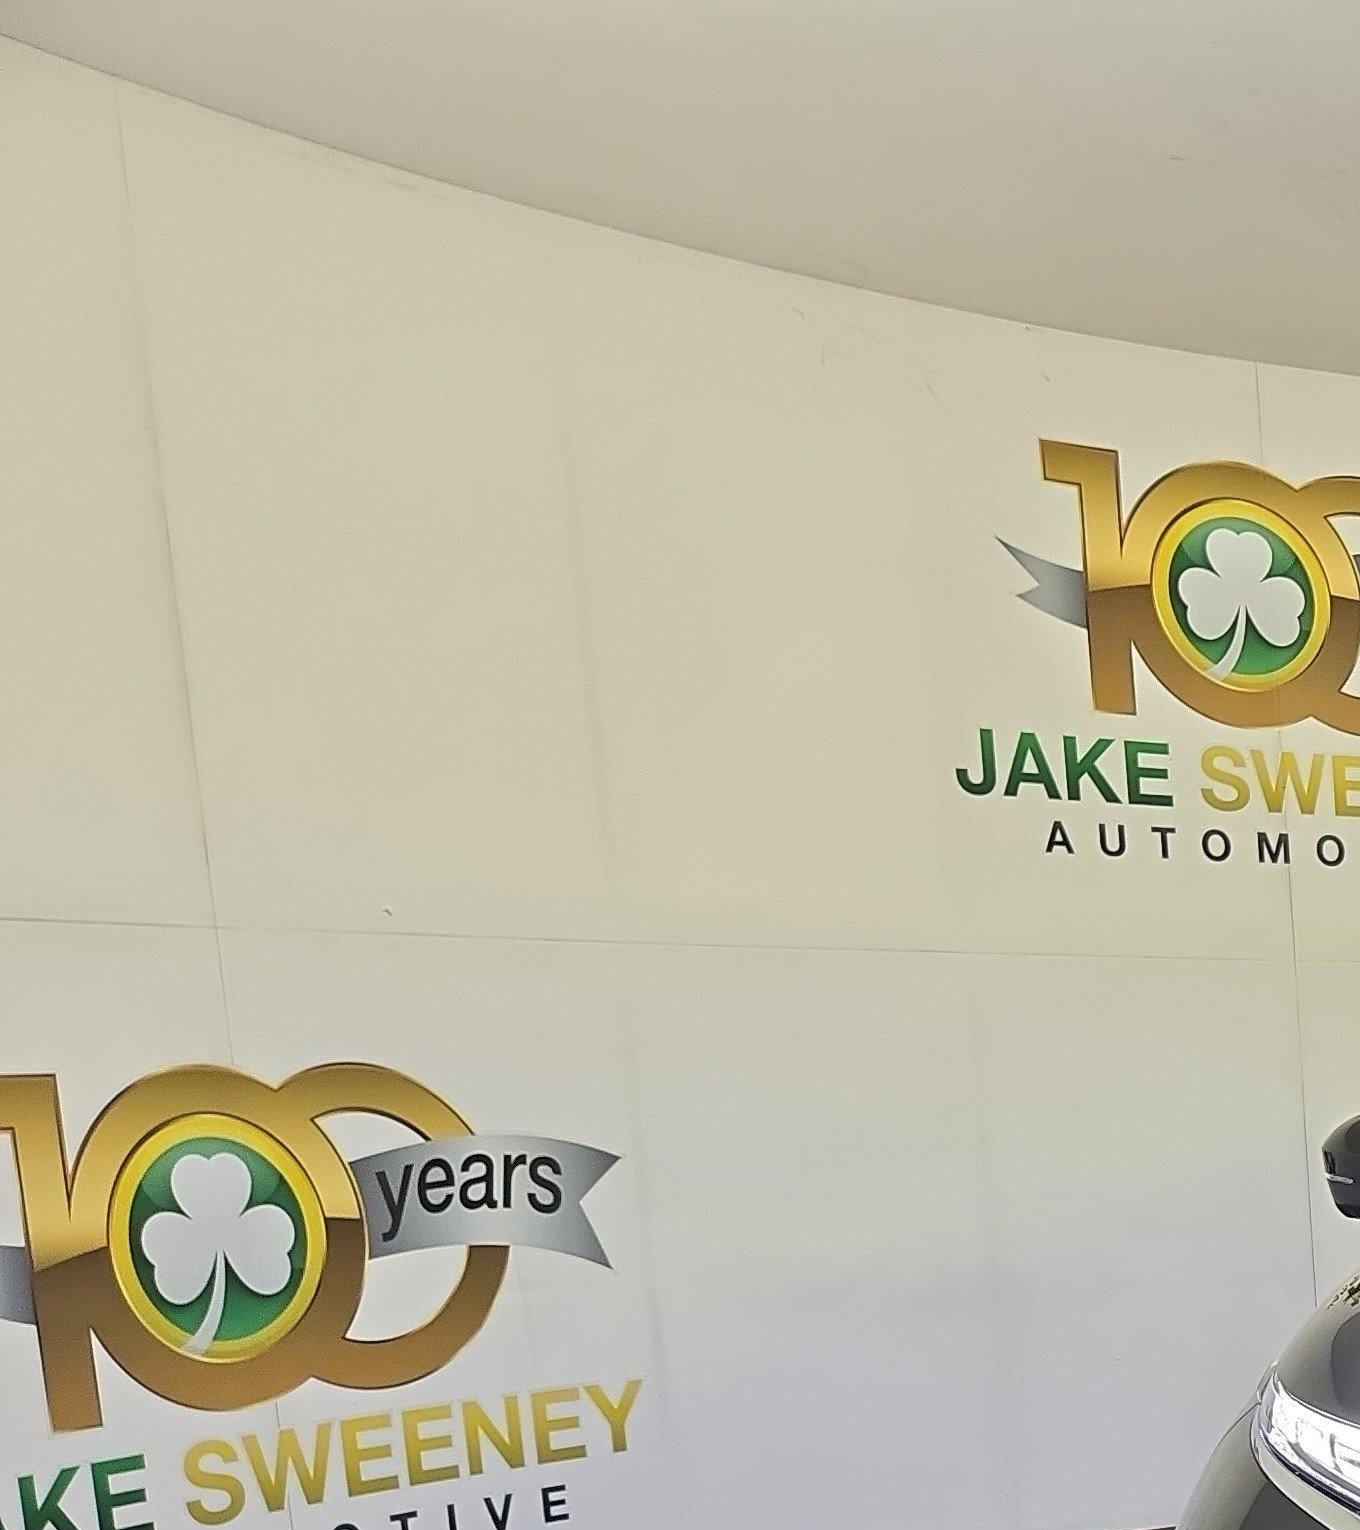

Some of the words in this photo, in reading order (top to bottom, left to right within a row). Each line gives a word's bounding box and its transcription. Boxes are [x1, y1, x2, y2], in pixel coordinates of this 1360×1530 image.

[955, 728, 1174, 807] JAKE
[376, 1154, 563, 1242] years
[183, 1379, 642, 1526] SWEENEY
